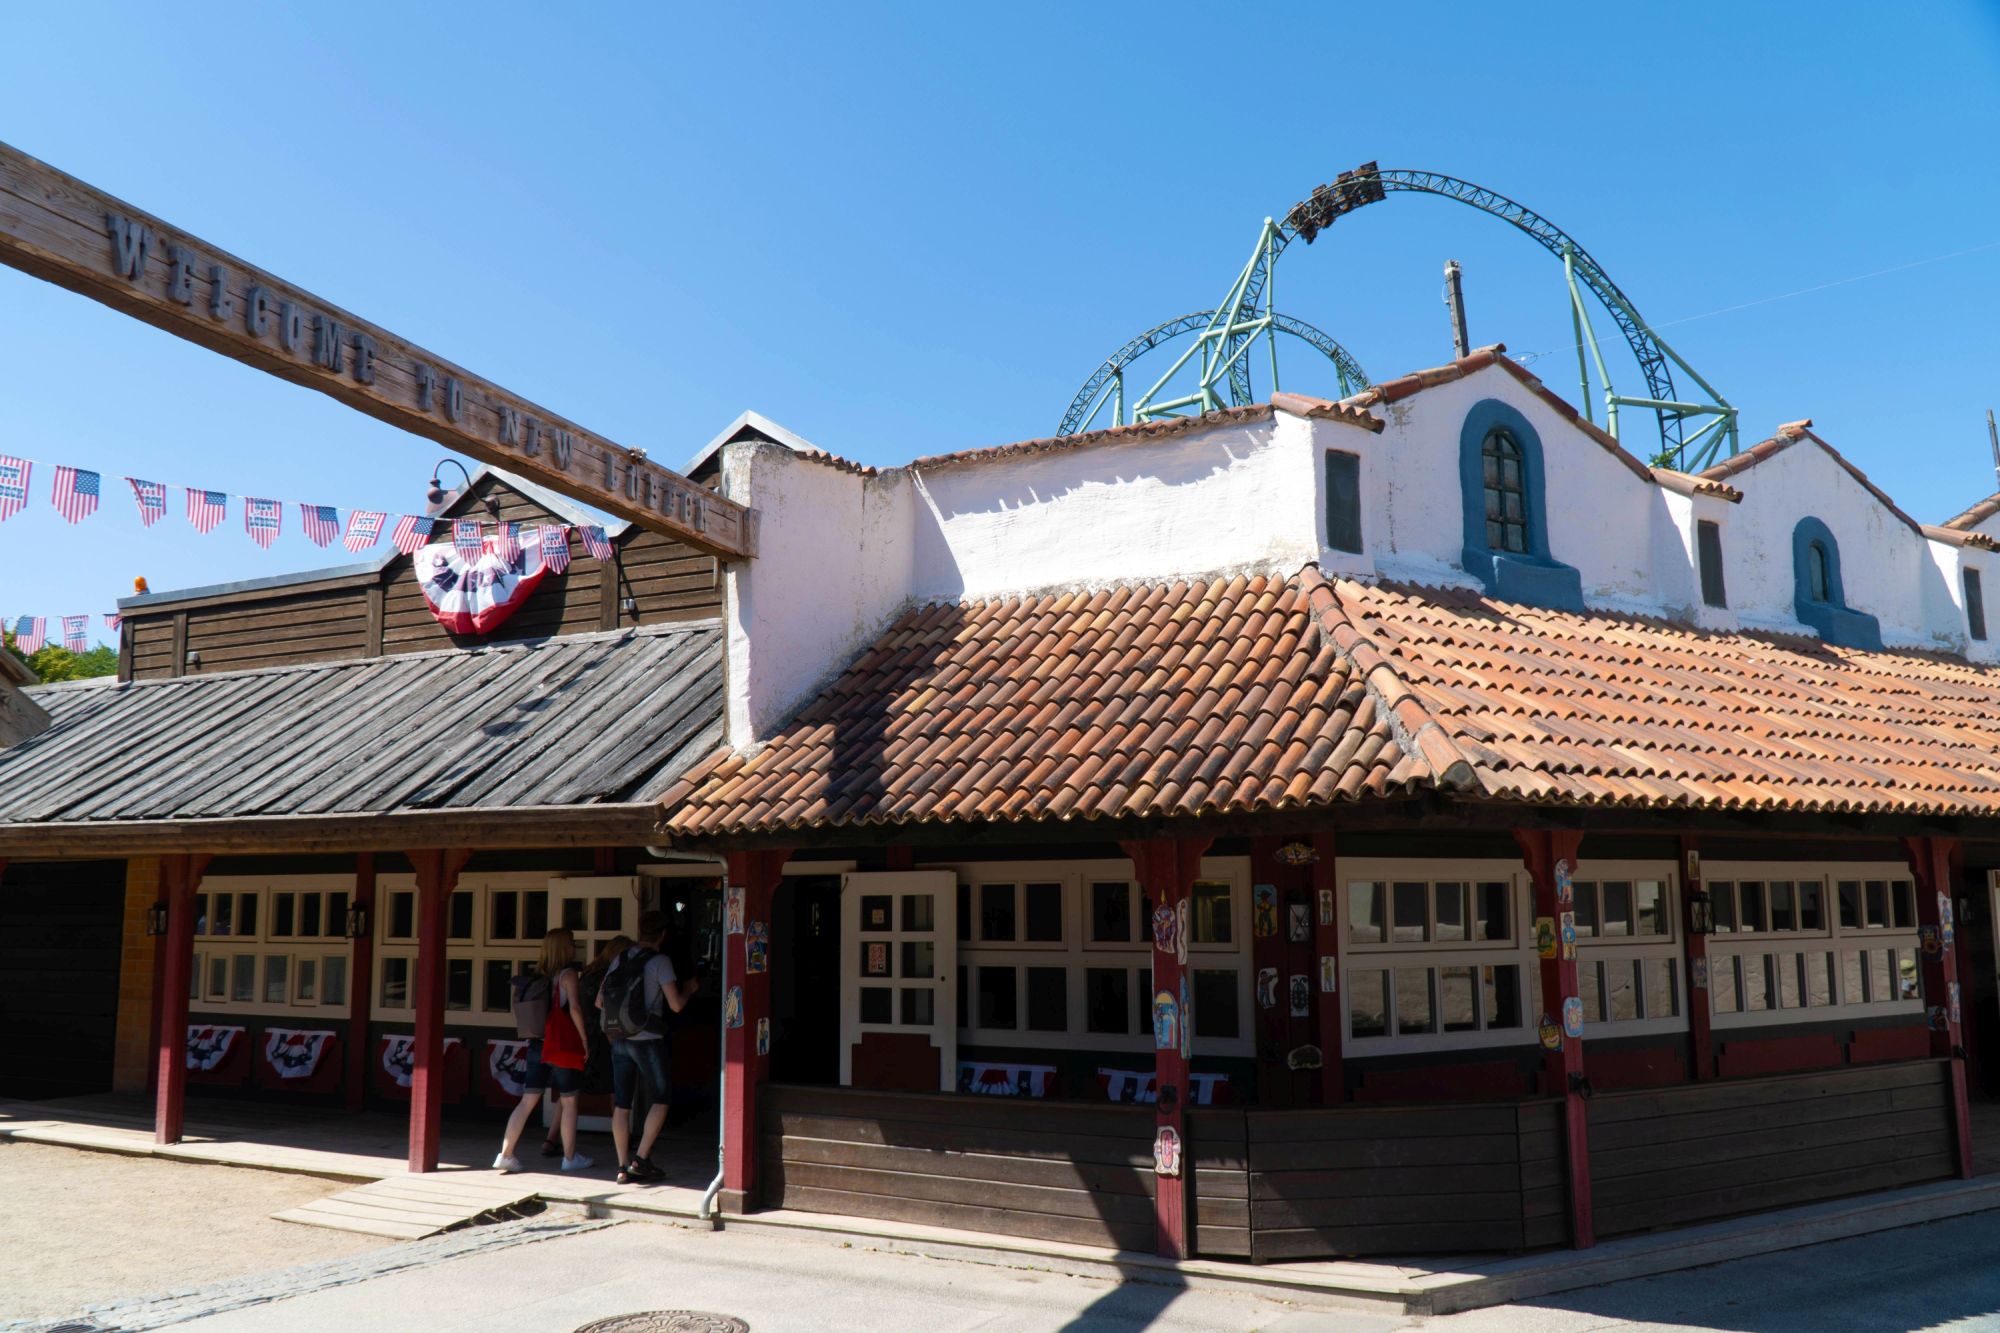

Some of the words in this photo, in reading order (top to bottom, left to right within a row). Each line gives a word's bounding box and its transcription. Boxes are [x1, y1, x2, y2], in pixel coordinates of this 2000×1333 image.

[107, 213, 377, 386] WELCOME
[416, 362, 464, 423] TO
[499, 404, 573, 471] NEW
